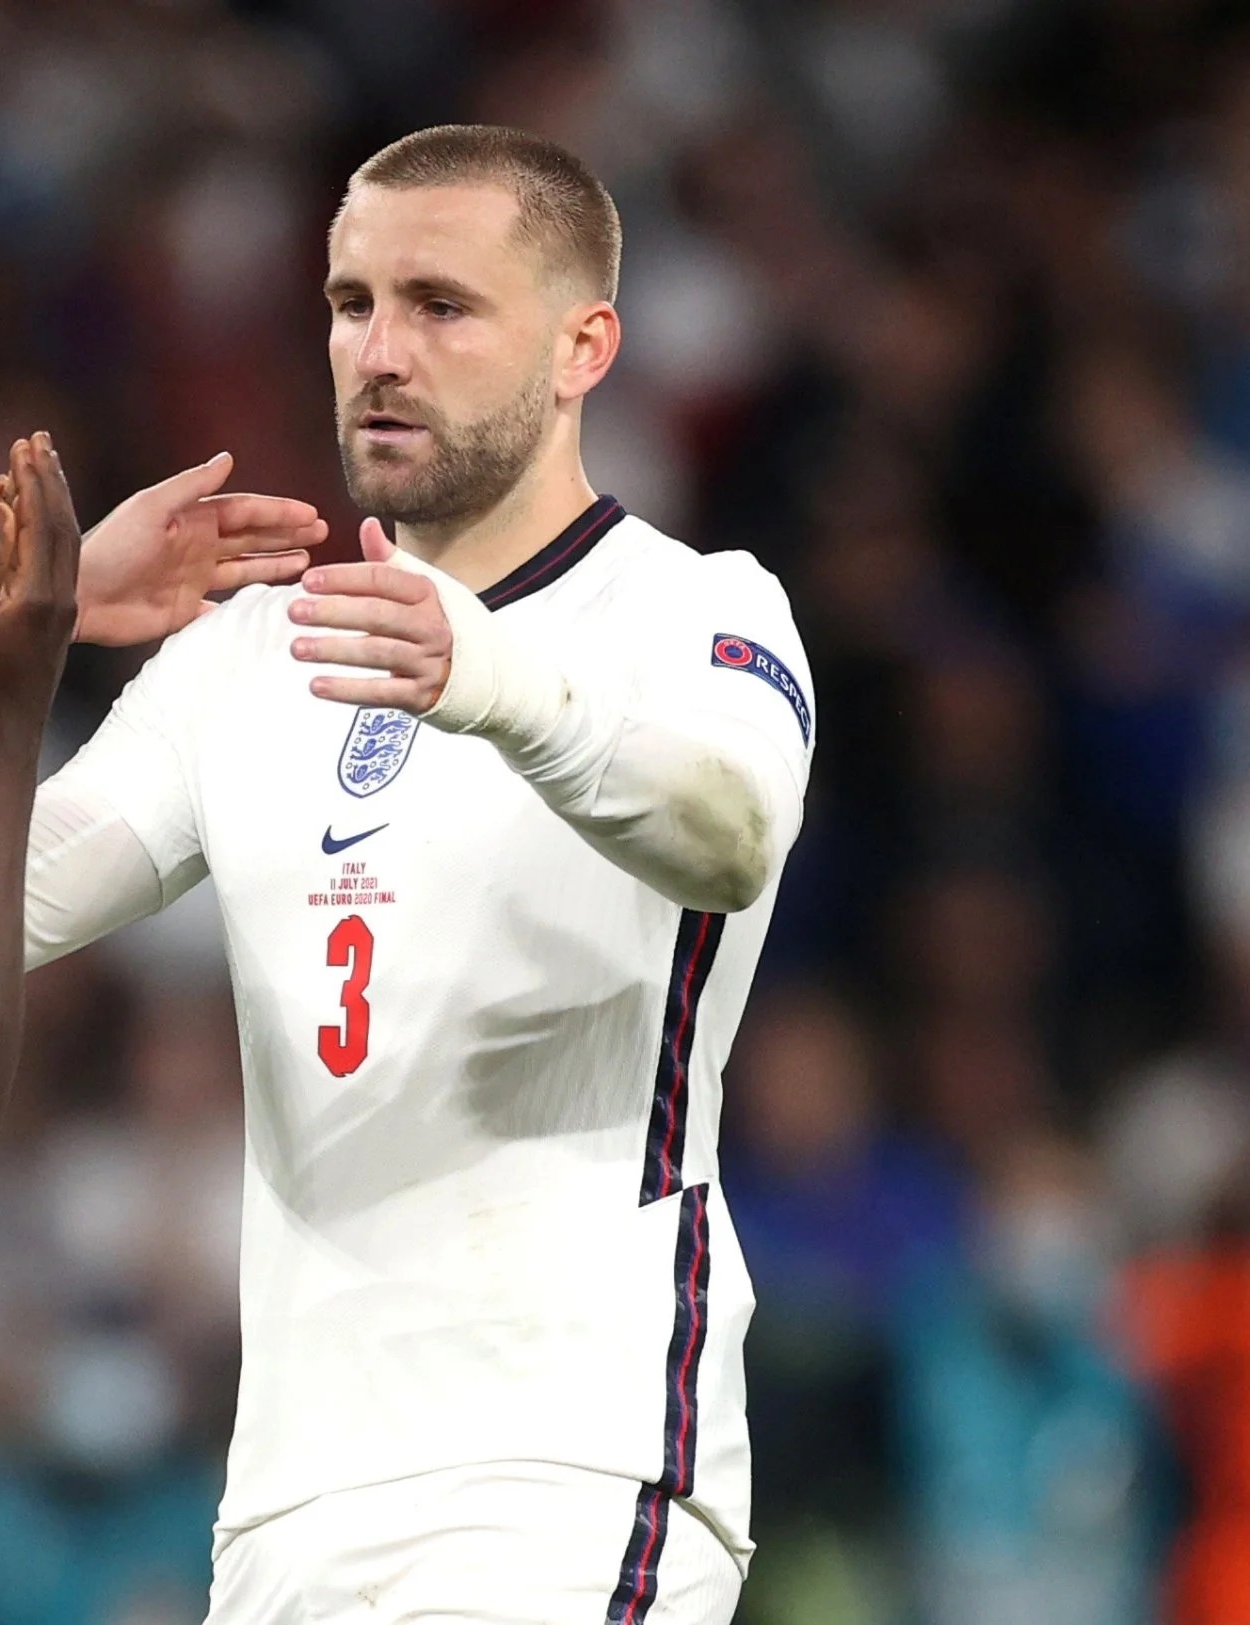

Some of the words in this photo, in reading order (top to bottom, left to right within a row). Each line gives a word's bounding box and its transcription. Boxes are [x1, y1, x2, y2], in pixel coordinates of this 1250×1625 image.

[756, 654, 810, 735] RESPECT
[342, 862, 366, 875] ITALY
[338, 878, 358, 890] JULY
[361, 877, 378, 889] 2021
[308, 893, 329, 905] UEFA
[331, 893, 352, 905] EURO
[354, 892, 372, 905] 2020
[374, 891, 396, 904] FINAL
[317, 914, 375, 1078] 3
